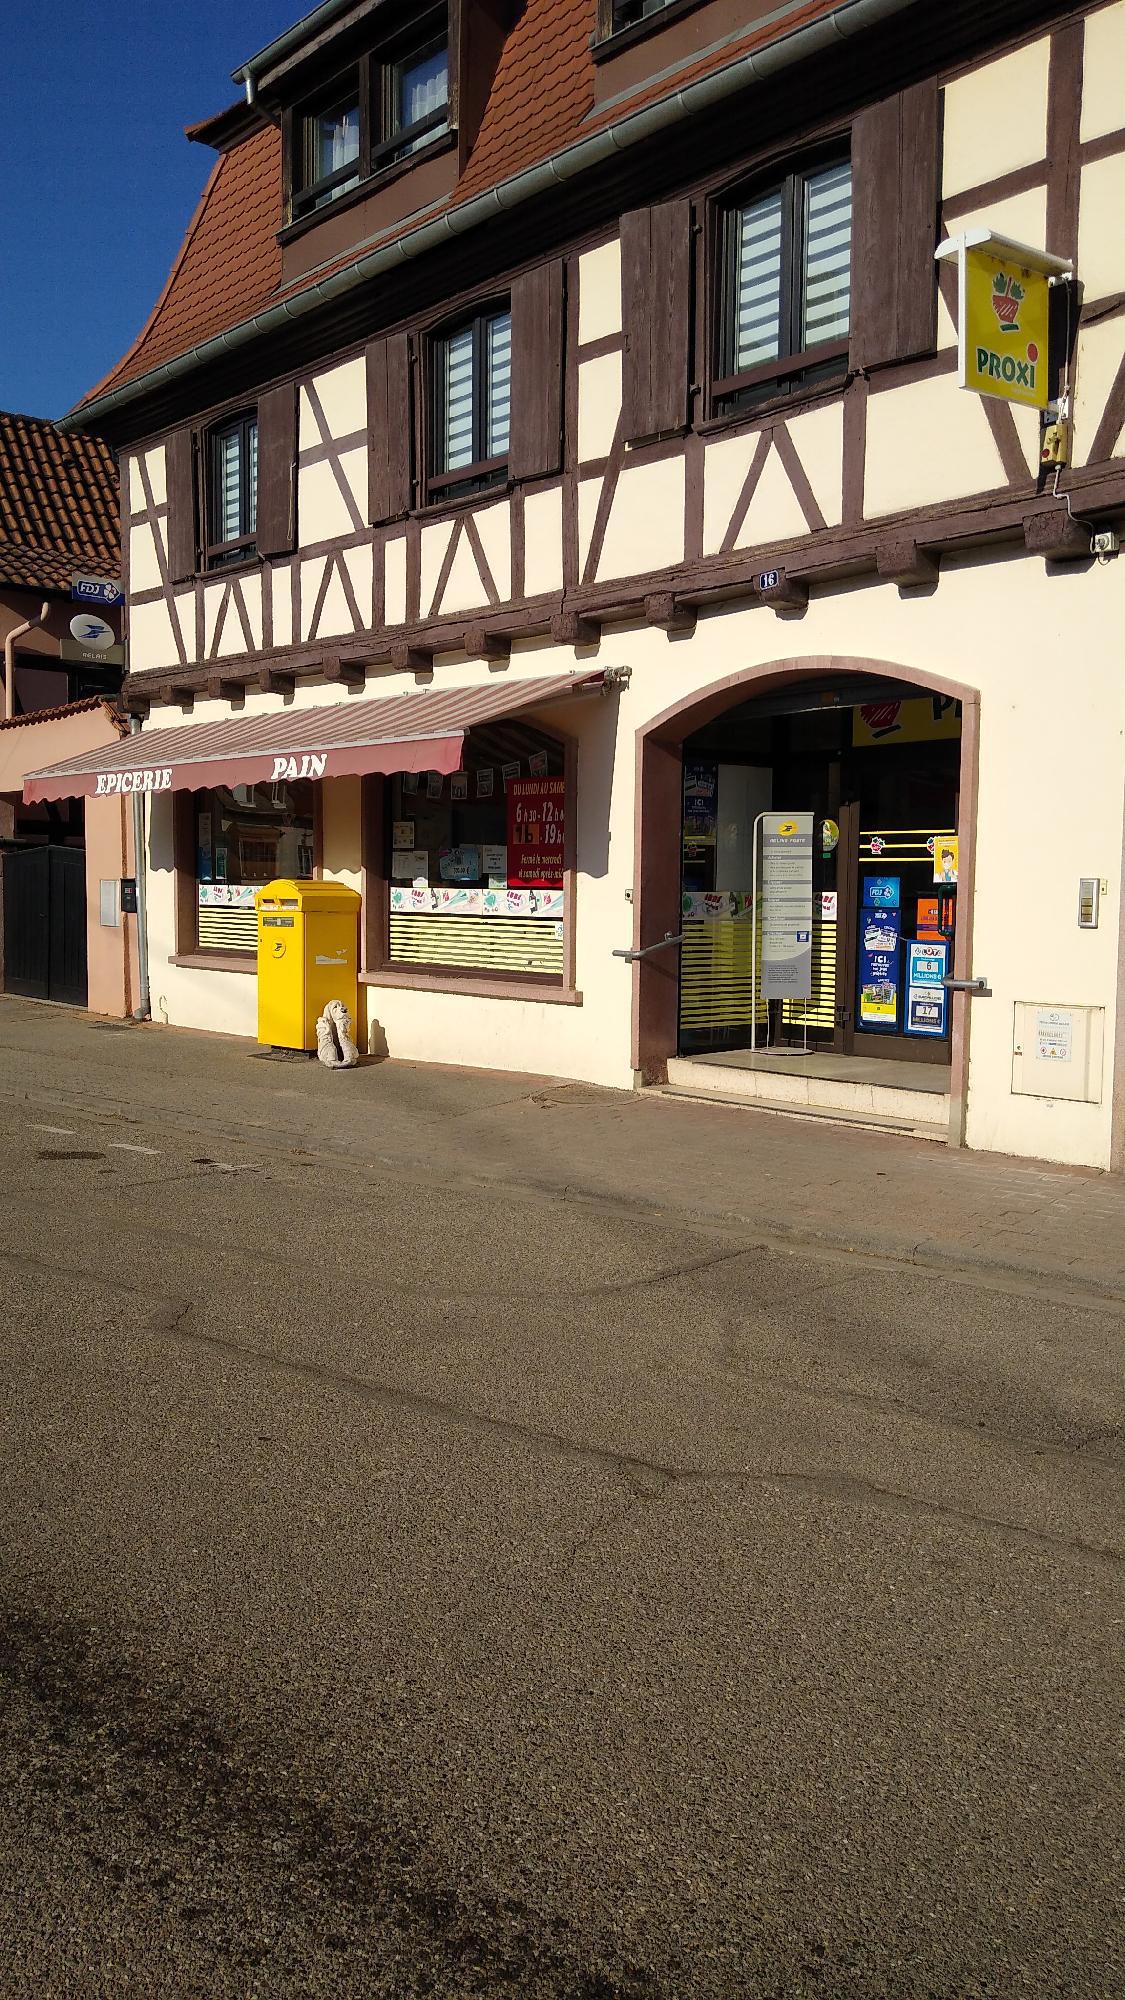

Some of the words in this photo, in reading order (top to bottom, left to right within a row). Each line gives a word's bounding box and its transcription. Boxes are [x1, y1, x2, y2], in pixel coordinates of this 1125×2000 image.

[976, 343, 1038, 389] PROXI
[764, 573, 775, 587] 16
[80, 582, 100, 595] FDJ
[82, 652, 107, 660] RELAIS
[270, 754, 328, 780] PAIN
[95, 768, 173, 794] EPICERIE
[513, 784, 521, 795] DU
[521, 783, 539, 796] LUNDI
[540, 782, 549, 794] AU
[874, 955, 887, 963] ICI
[926, 962, 932, 970] 6
[922, 1006, 933, 1015] 17
[912, 1016, 937, 1024] MILLIONS
